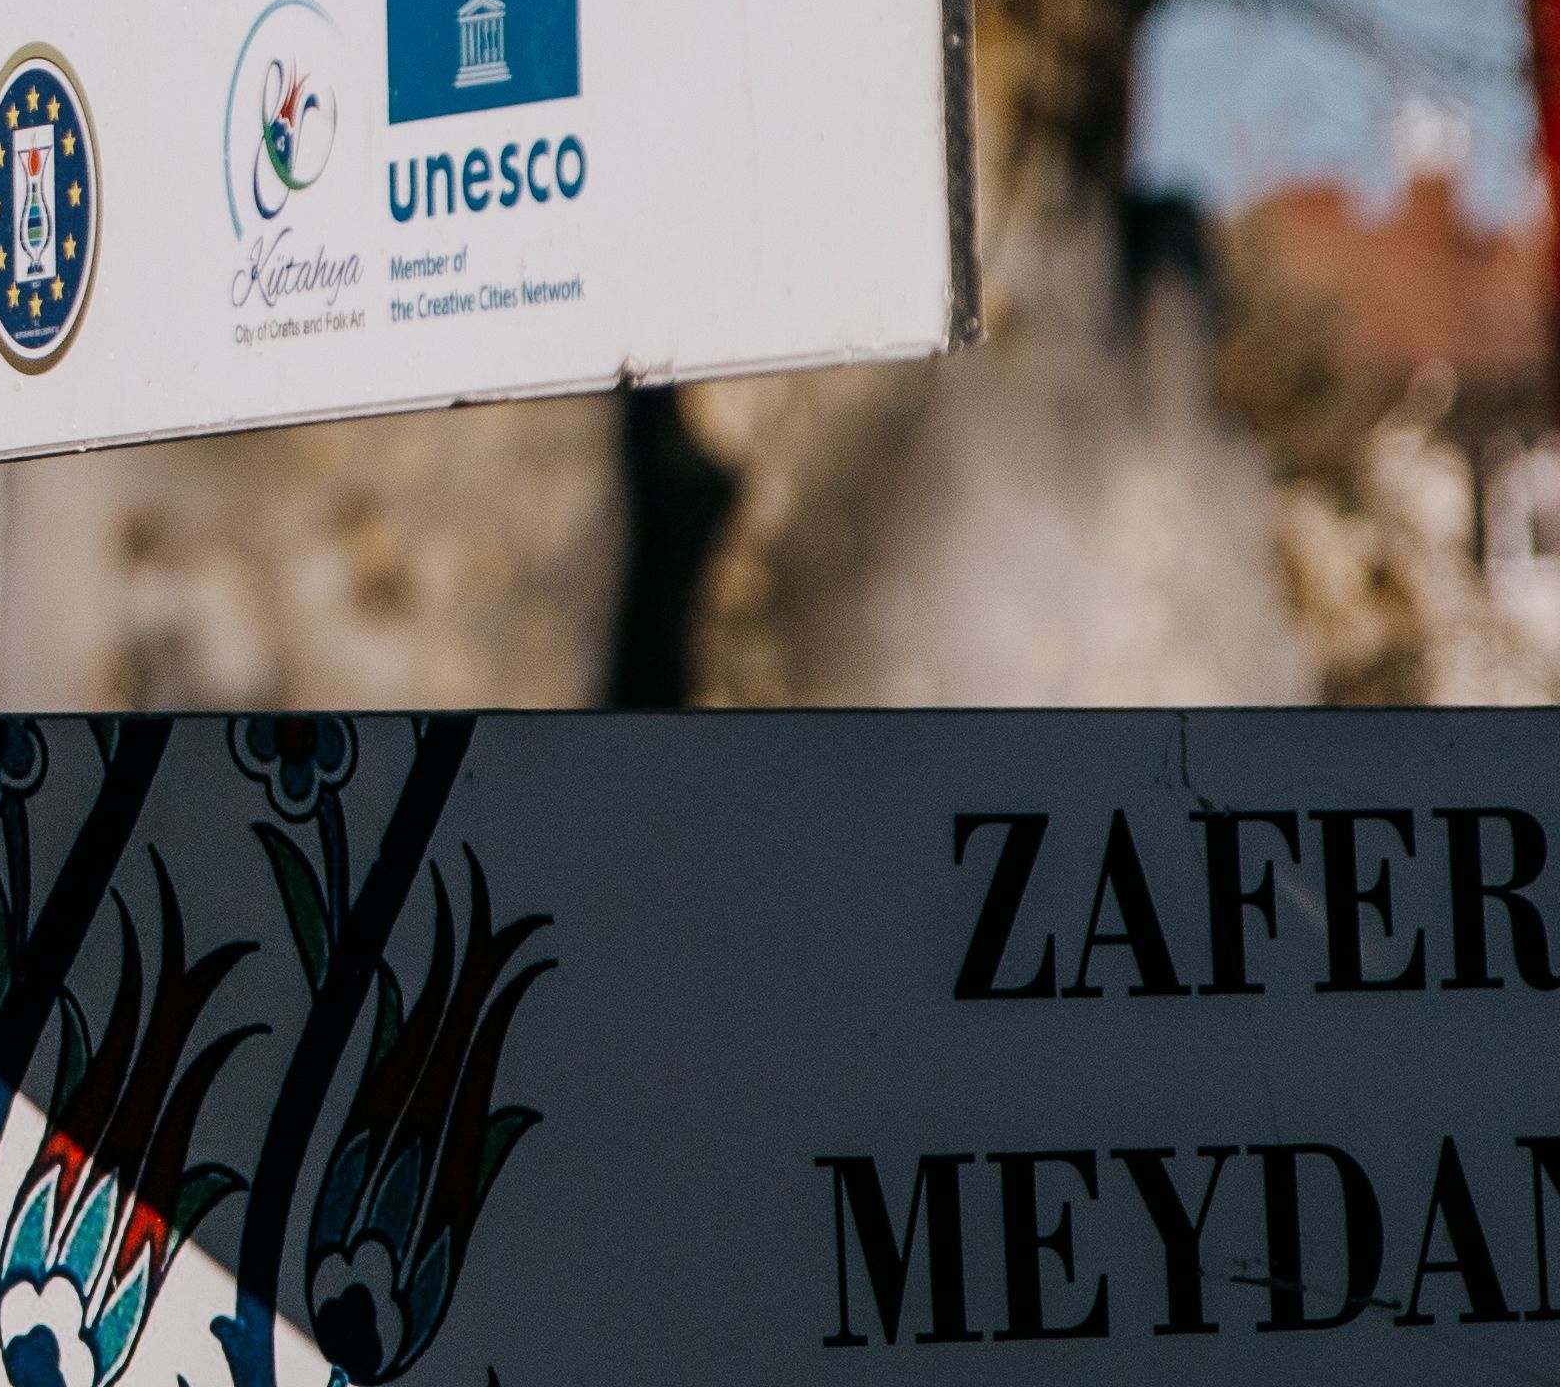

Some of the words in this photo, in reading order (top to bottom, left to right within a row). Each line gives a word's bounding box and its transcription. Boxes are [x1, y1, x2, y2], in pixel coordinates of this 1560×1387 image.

[389, 133, 586, 223] unesco
[231, 226, 364, 308] Kütahya
[390, 251, 450, 281] Member
[453, 244, 469, 273] of
[235, 324, 255, 347] City
[257, 323, 267, 341] of
[270, 318, 300, 339] Crafts
[303, 314, 323, 335] and
[326, 311, 349, 331] Folk
[351, 309, 366, 329] Art
[390, 294, 415, 323] the
[418, 289, 476, 319] Creative
[479, 283, 519, 312] Cities
[522, 275, 585, 306] Network
[953, 806, 1560, 1001] ZAFER
